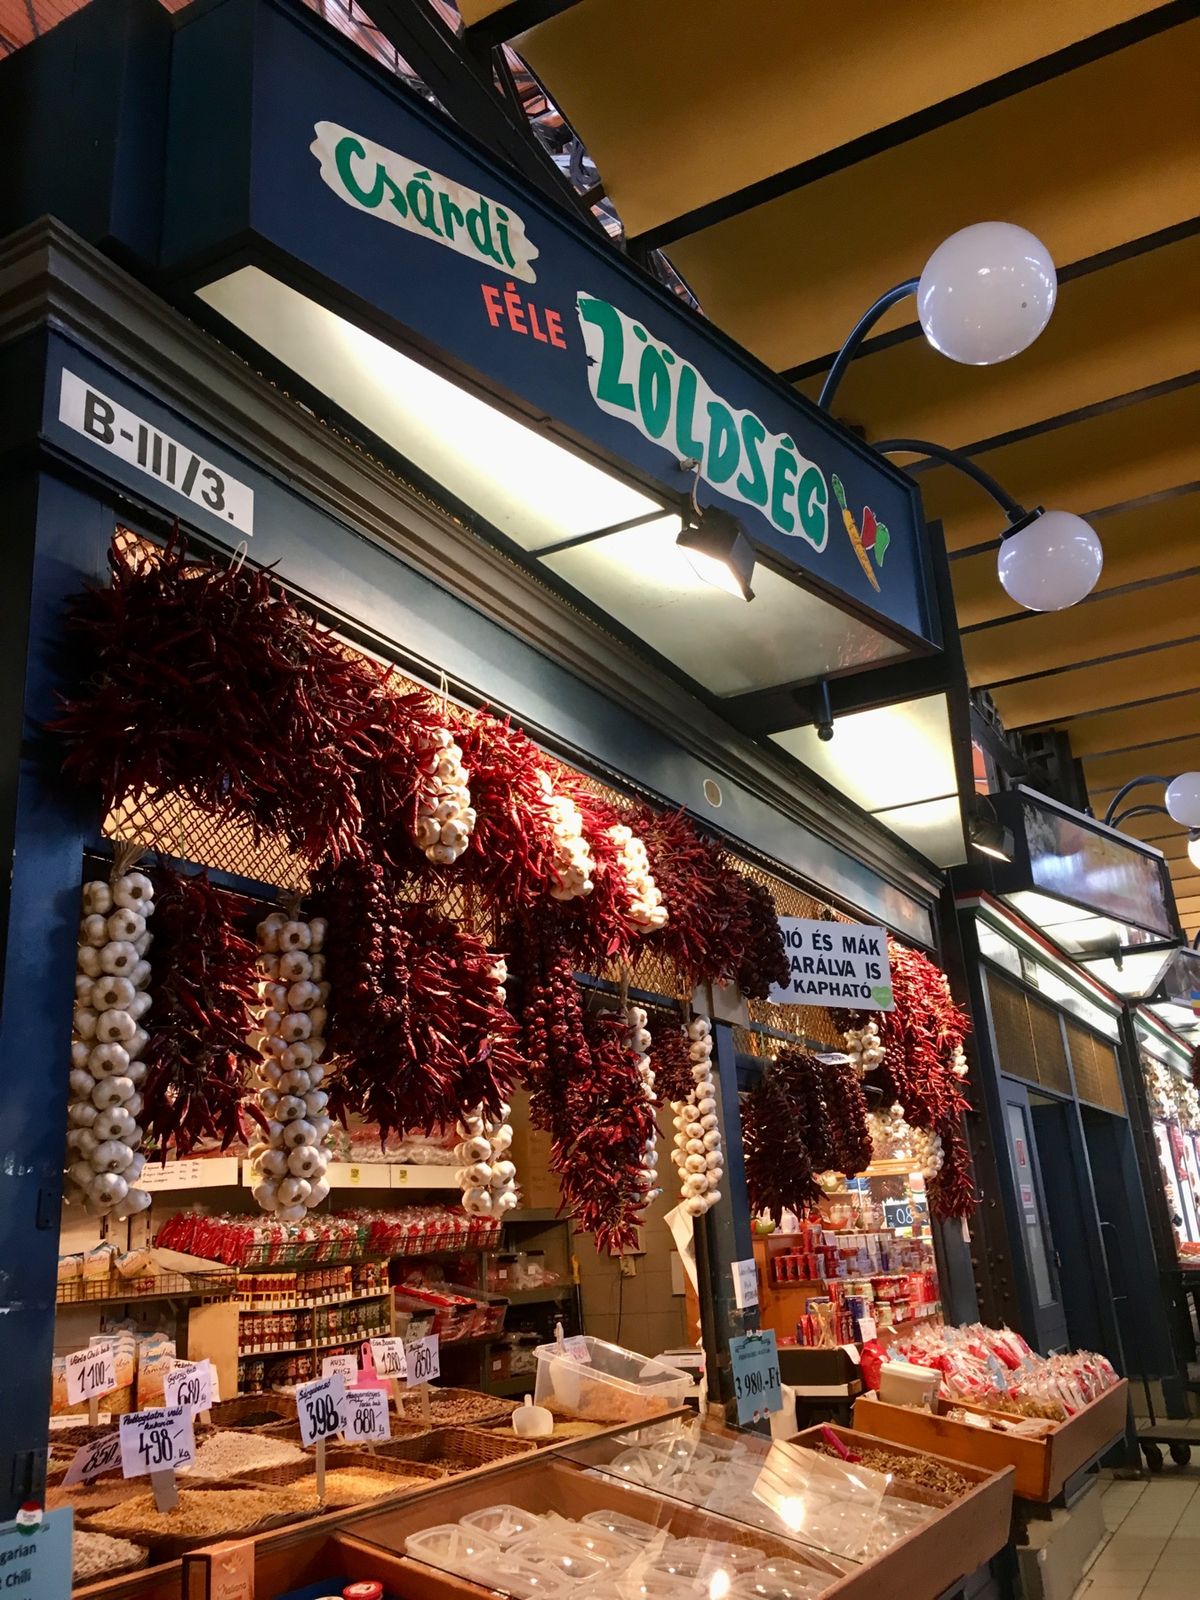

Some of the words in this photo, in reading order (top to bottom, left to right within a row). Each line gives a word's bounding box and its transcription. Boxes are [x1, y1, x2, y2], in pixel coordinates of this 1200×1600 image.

[334, 136, 518, 270] Csárdi
[480, 281, 567, 350] FÉLE
[83, 390, 236, 521] B-III/3.
[578, 298, 828, 547] ZÖLDSÉG
[791, 954, 857, 977] ARÁLVA
[865, 962, 881, 980] IS
[812, 929, 833, 951] ÉS
[842, 934, 881, 956] MÁK
[793, 980, 872, 999] KAPHATÓ
